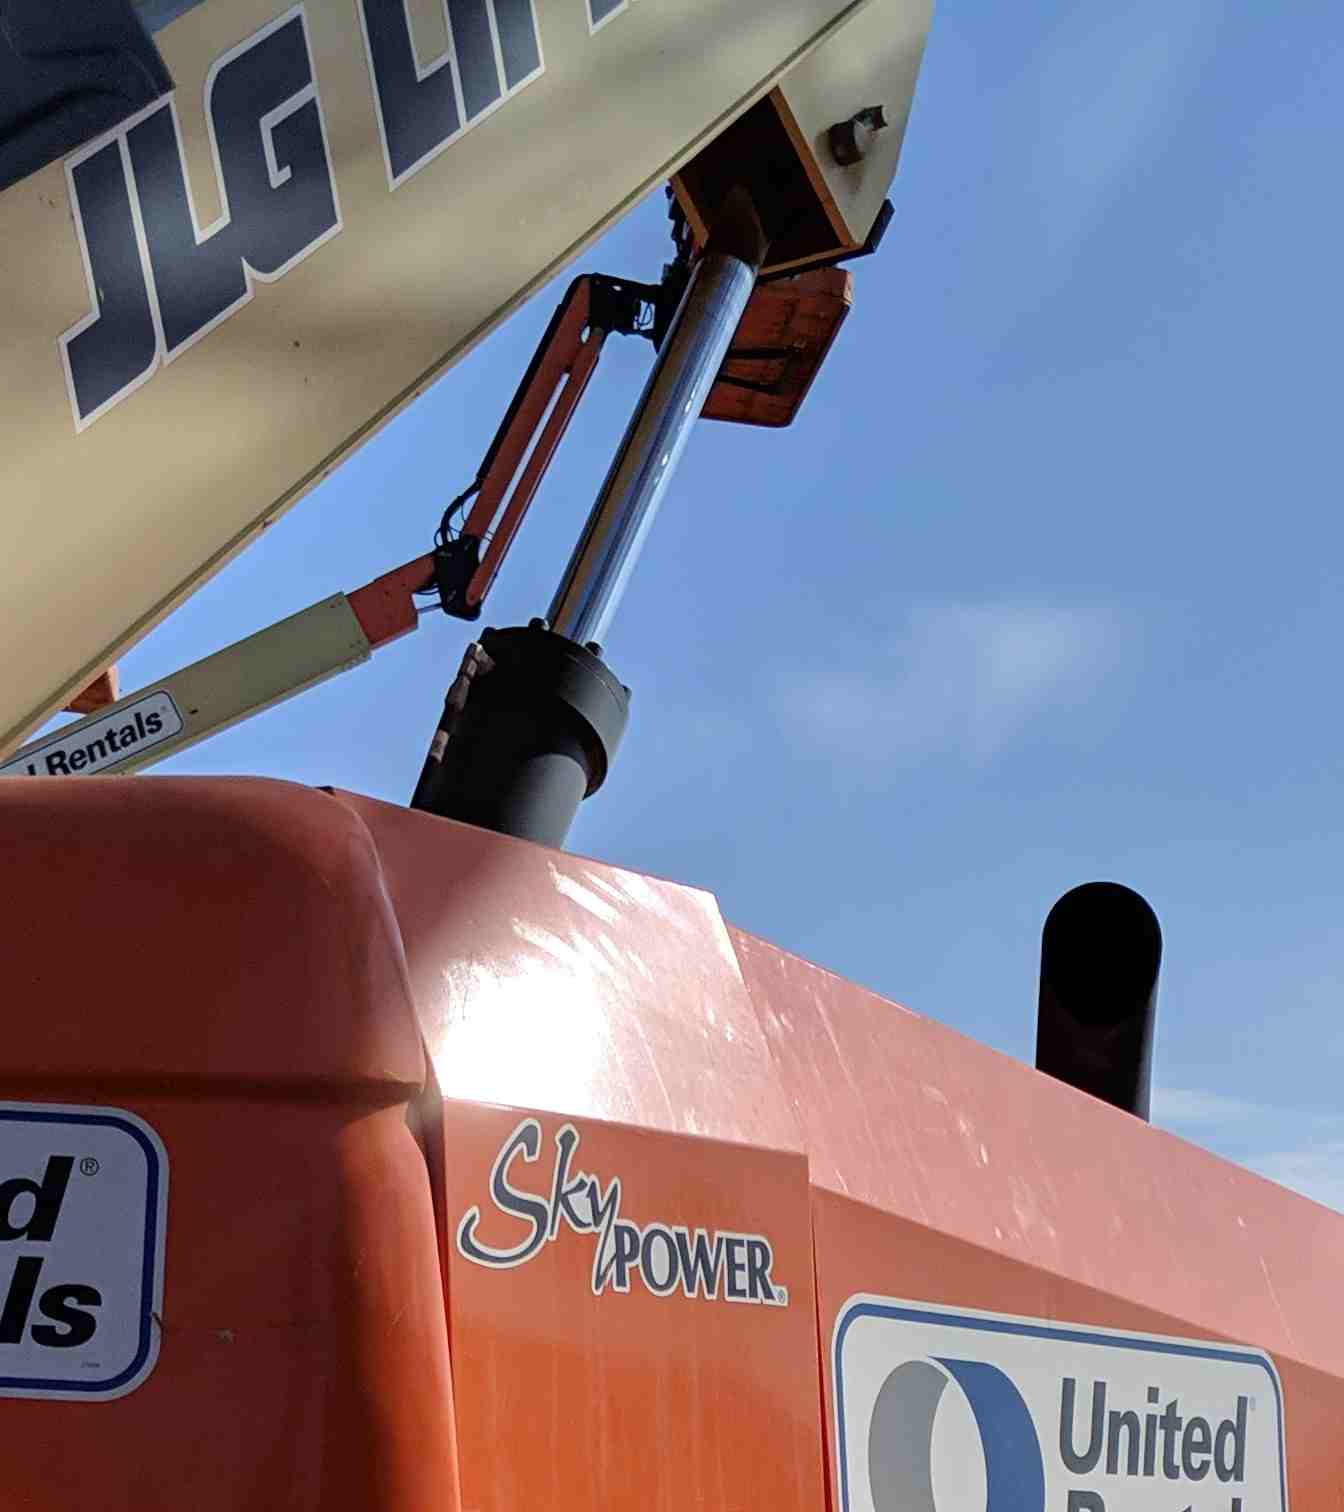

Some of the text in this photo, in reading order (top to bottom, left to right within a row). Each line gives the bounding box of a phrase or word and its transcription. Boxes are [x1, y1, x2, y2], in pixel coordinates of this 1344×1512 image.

[57, 4, 343, 434] JLG
[45, 711, 164, 776] Rentals
[458, 1119, 778, 1304] Sky POWER
[1058, 1376, 1250, 1483] United
